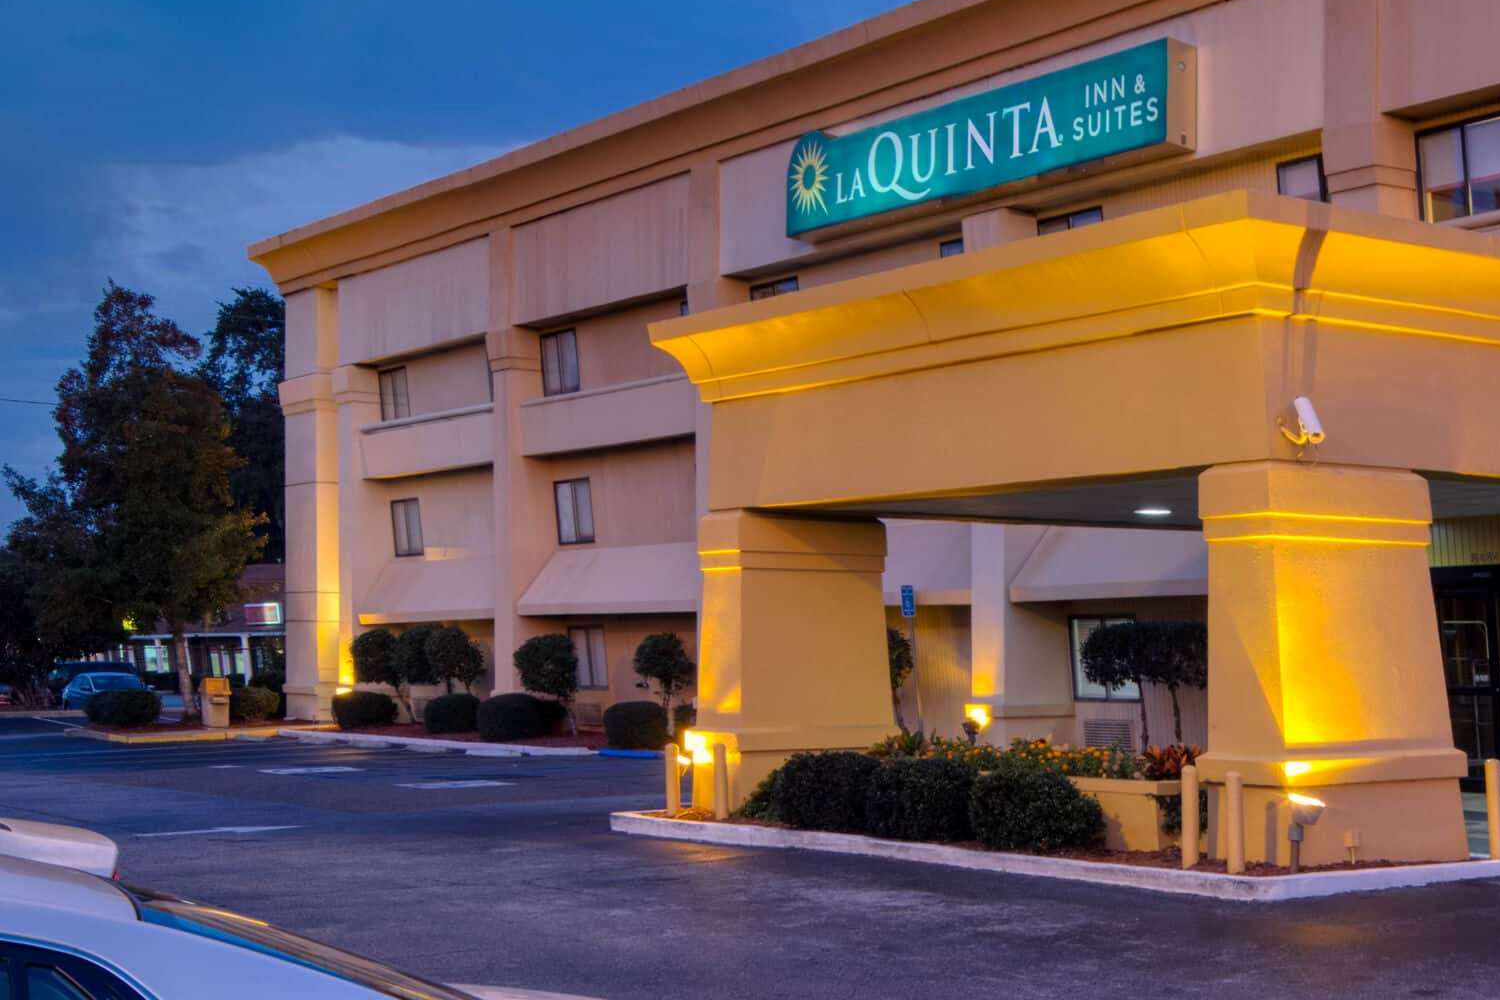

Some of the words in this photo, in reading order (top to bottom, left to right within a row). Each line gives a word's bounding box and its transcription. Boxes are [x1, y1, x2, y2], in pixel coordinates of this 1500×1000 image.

[1084, 73, 1126, 109] INN
[1133, 72, 1146, 95] &
[1072, 96, 1159, 142] SUITES
[835, 167, 867, 204] LA
[867, 95, 1064, 201] QUINTA
